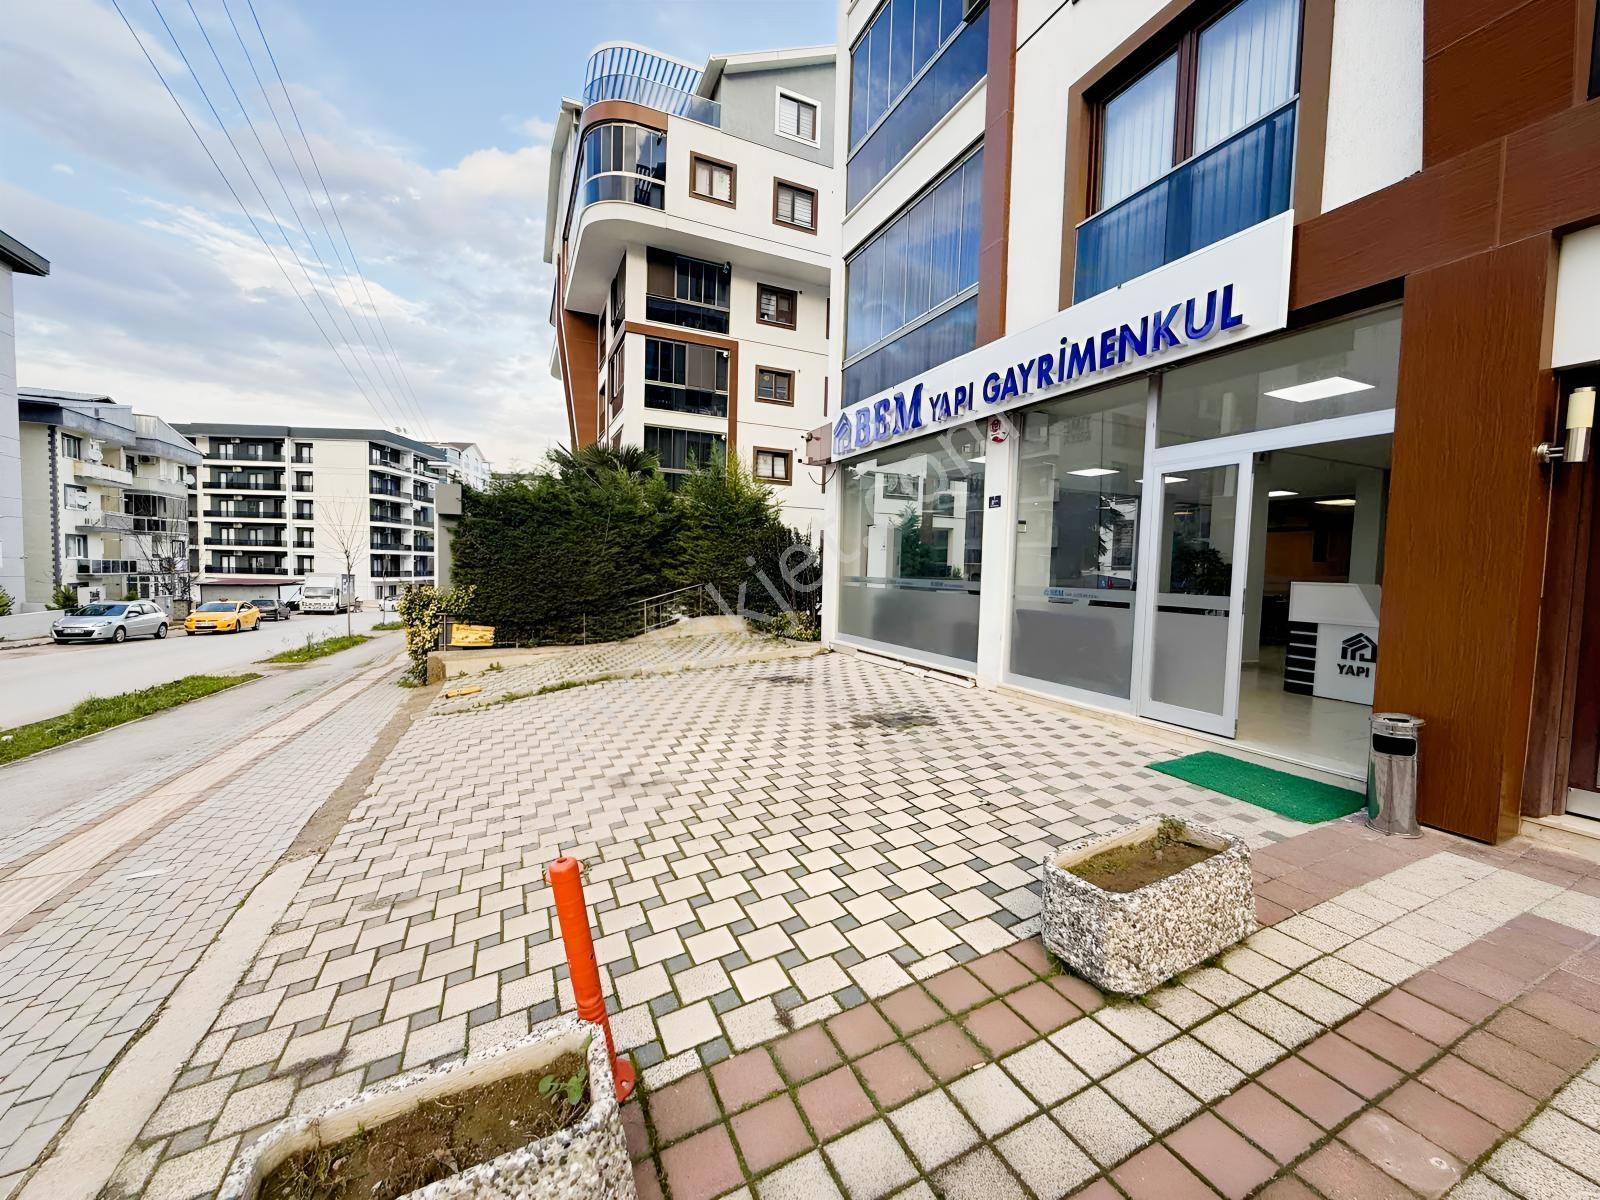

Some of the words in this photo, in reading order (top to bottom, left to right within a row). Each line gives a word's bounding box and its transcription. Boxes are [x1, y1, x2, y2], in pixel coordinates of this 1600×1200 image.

[855, 383, 924, 448] BEM
[929, 381, 974, 422] YAPI
[982, 283, 1243, 405] GAYRİMENKUL
[1336, 663, 1370, 678] YAPI
